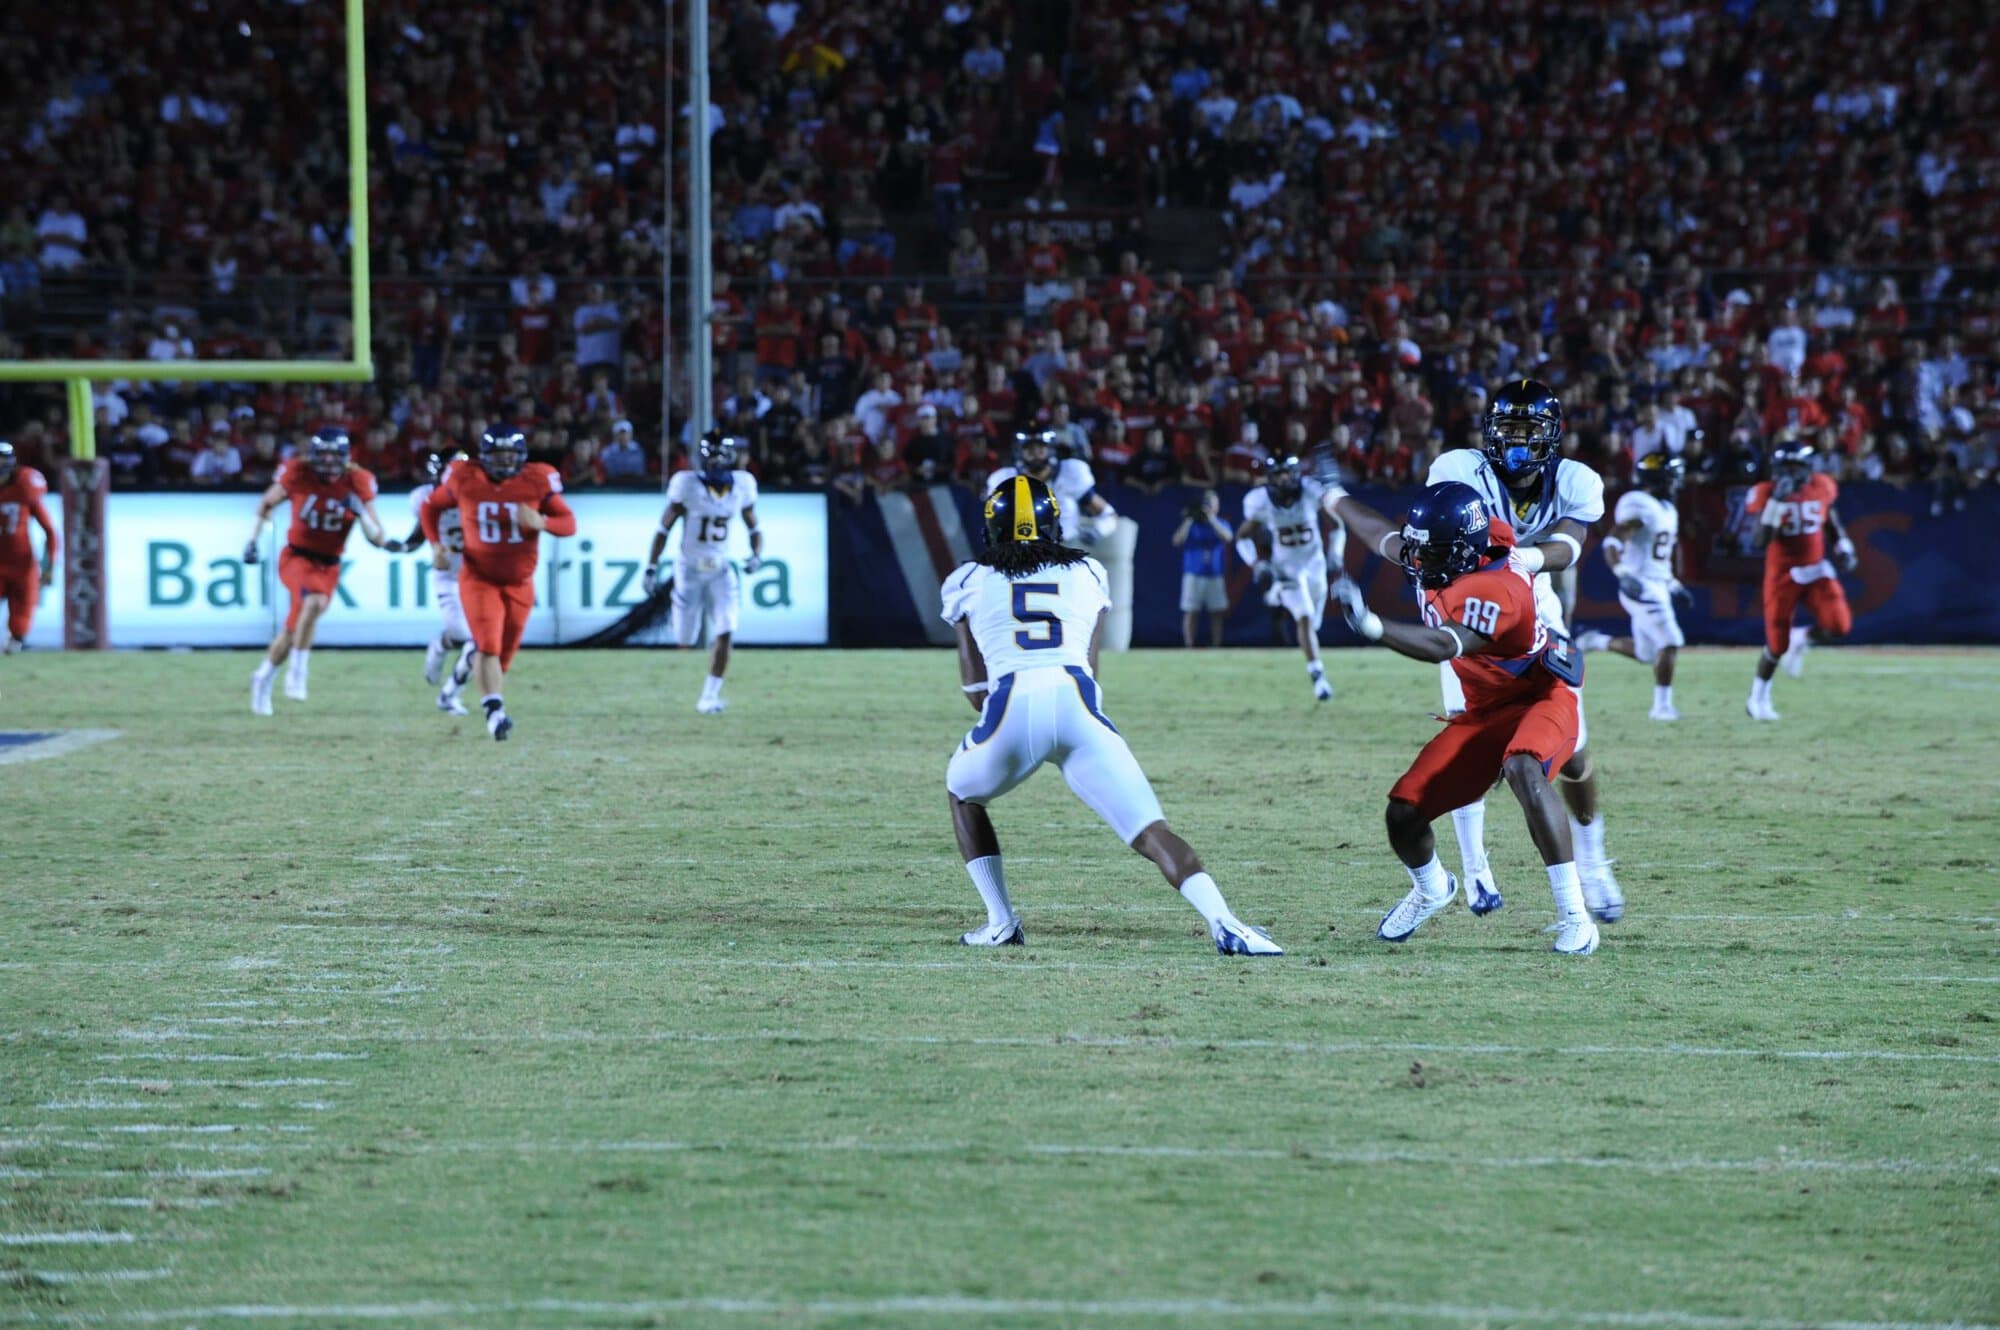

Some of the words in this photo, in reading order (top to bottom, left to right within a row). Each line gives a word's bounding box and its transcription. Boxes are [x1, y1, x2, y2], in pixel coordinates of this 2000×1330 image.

[300, 494, 344, 532] 42
[477, 501, 524, 545] 61
[699, 515, 729, 542] 15
[1779, 501, 1824, 536] 35
[1009, 582, 1063, 651] 5
[1463, 597, 1501, 636] 89
